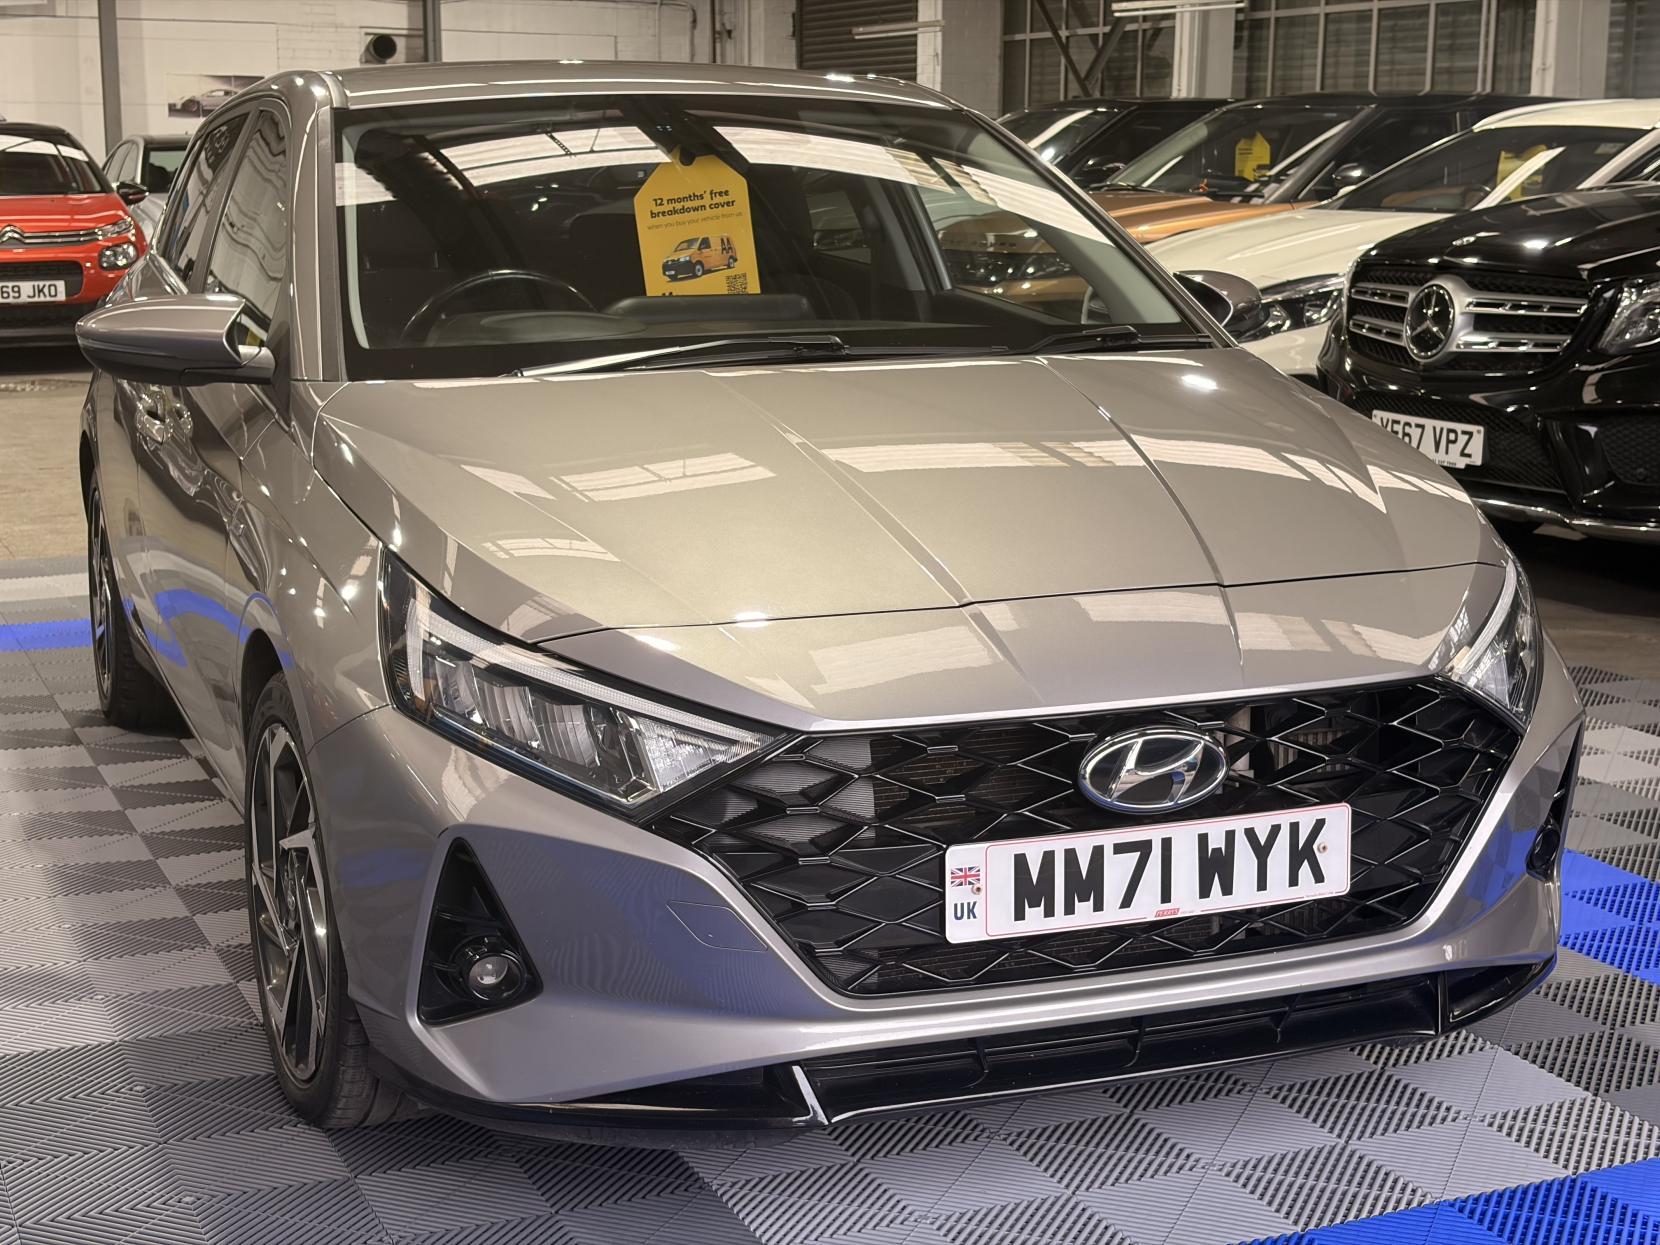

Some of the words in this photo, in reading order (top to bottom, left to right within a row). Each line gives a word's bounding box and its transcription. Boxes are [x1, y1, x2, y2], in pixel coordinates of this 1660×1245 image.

[653, 197, 664, 207] 12
[709, 189, 730, 200] free
[650, 204, 707, 219] breakdown
[708, 199, 736, 210] cover
[720, 237, 734, 255] AA
[27, 283, 58, 299] JKO
[1432, 425, 1474, 458] VPZ
[1013, 837, 1173, 922] MM71
[1197, 817, 1327, 900] WYK
[953, 900, 978, 921] UK
